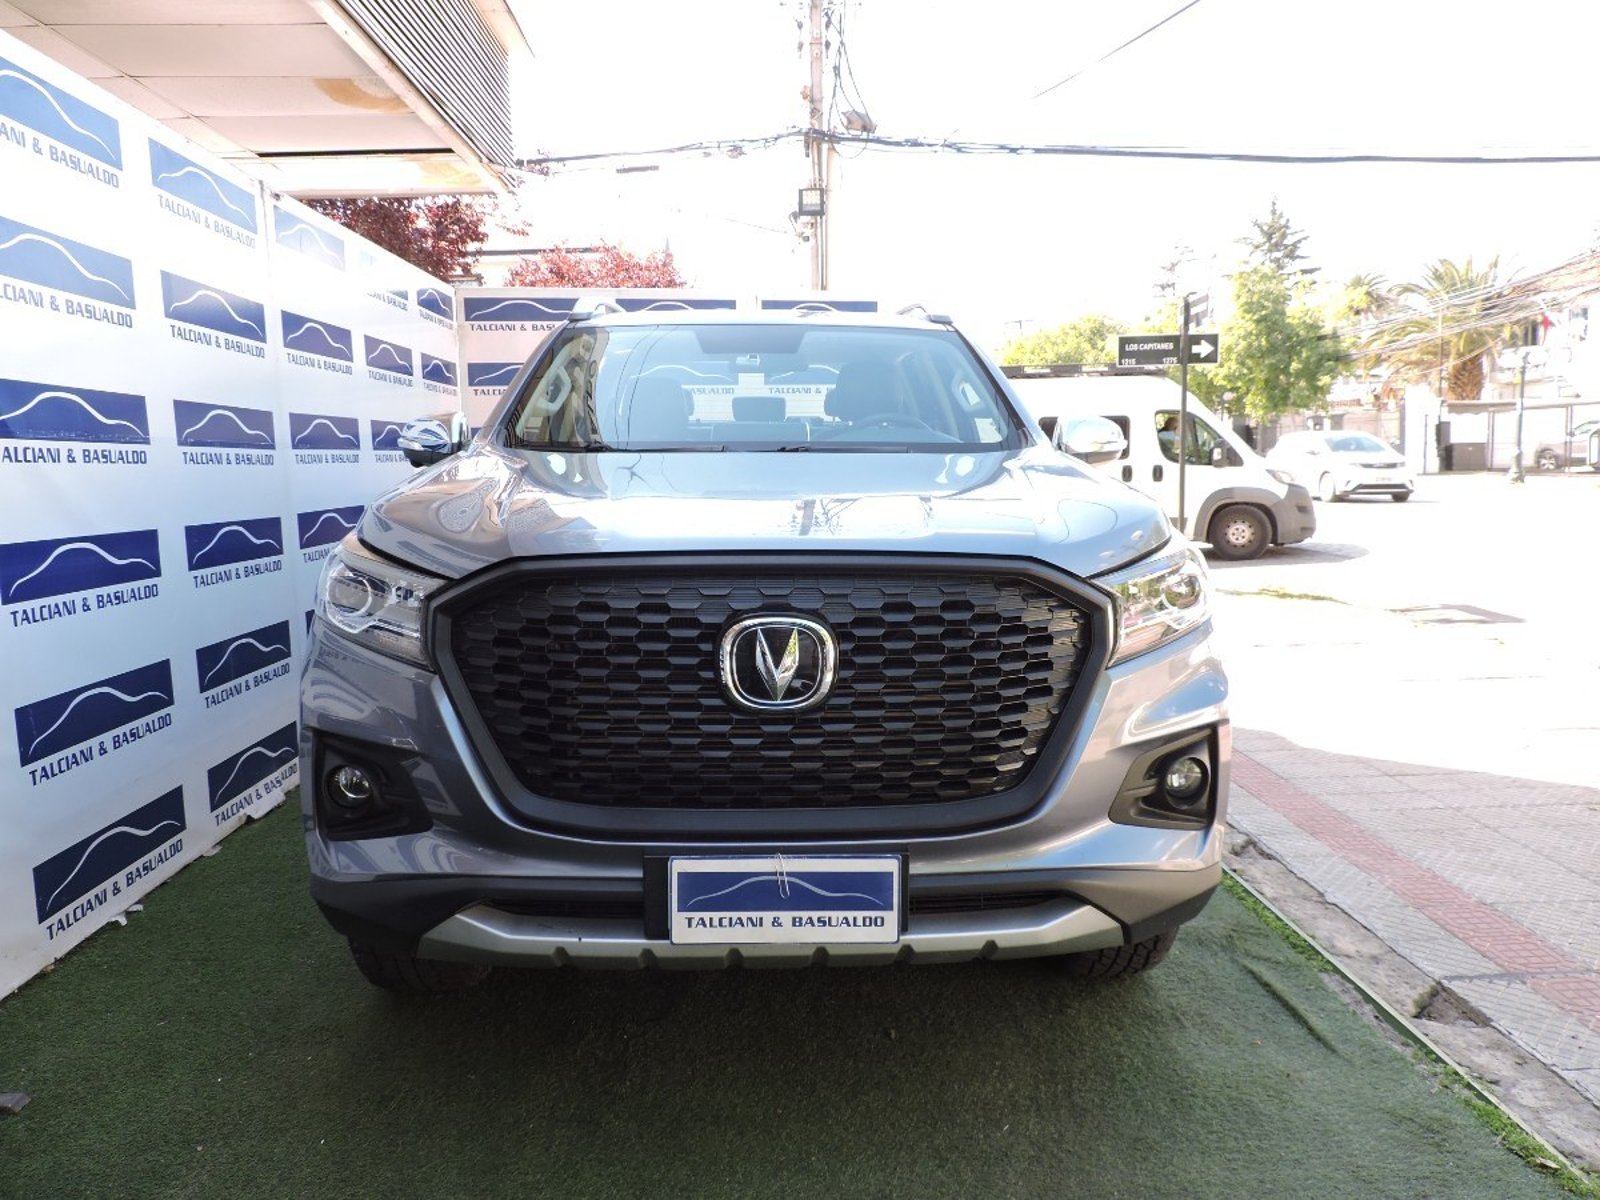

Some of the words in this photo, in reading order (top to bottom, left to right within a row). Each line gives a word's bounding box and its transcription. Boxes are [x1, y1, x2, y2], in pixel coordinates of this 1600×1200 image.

[33, 137, 43, 155] &
[49, 144, 119, 188] BASUALDO
[50, 295, 60, 312] &
[65, 299, 133, 328] BASUALDO
[470, 323, 516, 331] TALCIANI
[520, 323, 527, 331] &
[170, 324, 212, 346] TALCIANI
[224, 338, 265, 359] BASUALDO
[1125, 343, 1138, 351] LOS
[1139, 342, 1174, 350] CAPITANES
[67, 448, 76, 464] &
[82, 449, 147, 465] BASUALDO
[182, 452, 223, 465] TALCIANI
[235, 454, 274, 465] BASUALDO
[193, 568, 233, 589] TALCIANI
[235, 566, 241, 580] &
[244, 559, 282, 578] BASUALDO
[10, 600, 77, 627] TALCIANI
[82, 597, 91, 612] &
[97, 583, 159, 609] BASUALDO
[205, 683, 243, 709] TALCIANI
[244, 677, 252, 690] &
[253, 663, 290, 688] BASUALDO
[29, 746, 94, 786] TALCIANI
[98, 741, 108, 756] &
[112, 713, 172, 747] BASUALDO
[215, 793, 254, 826] TALCIANI
[255, 789, 263, 801] &
[46, 892, 108, 941] TALCIANI
[112, 880, 121, 896] &
[125, 838, 183, 889] BASUALDO
[684, 916, 763, 929] TALCIANI
[771, 916, 784, 928] &
[791, 915, 885, 928] BASUALDO
